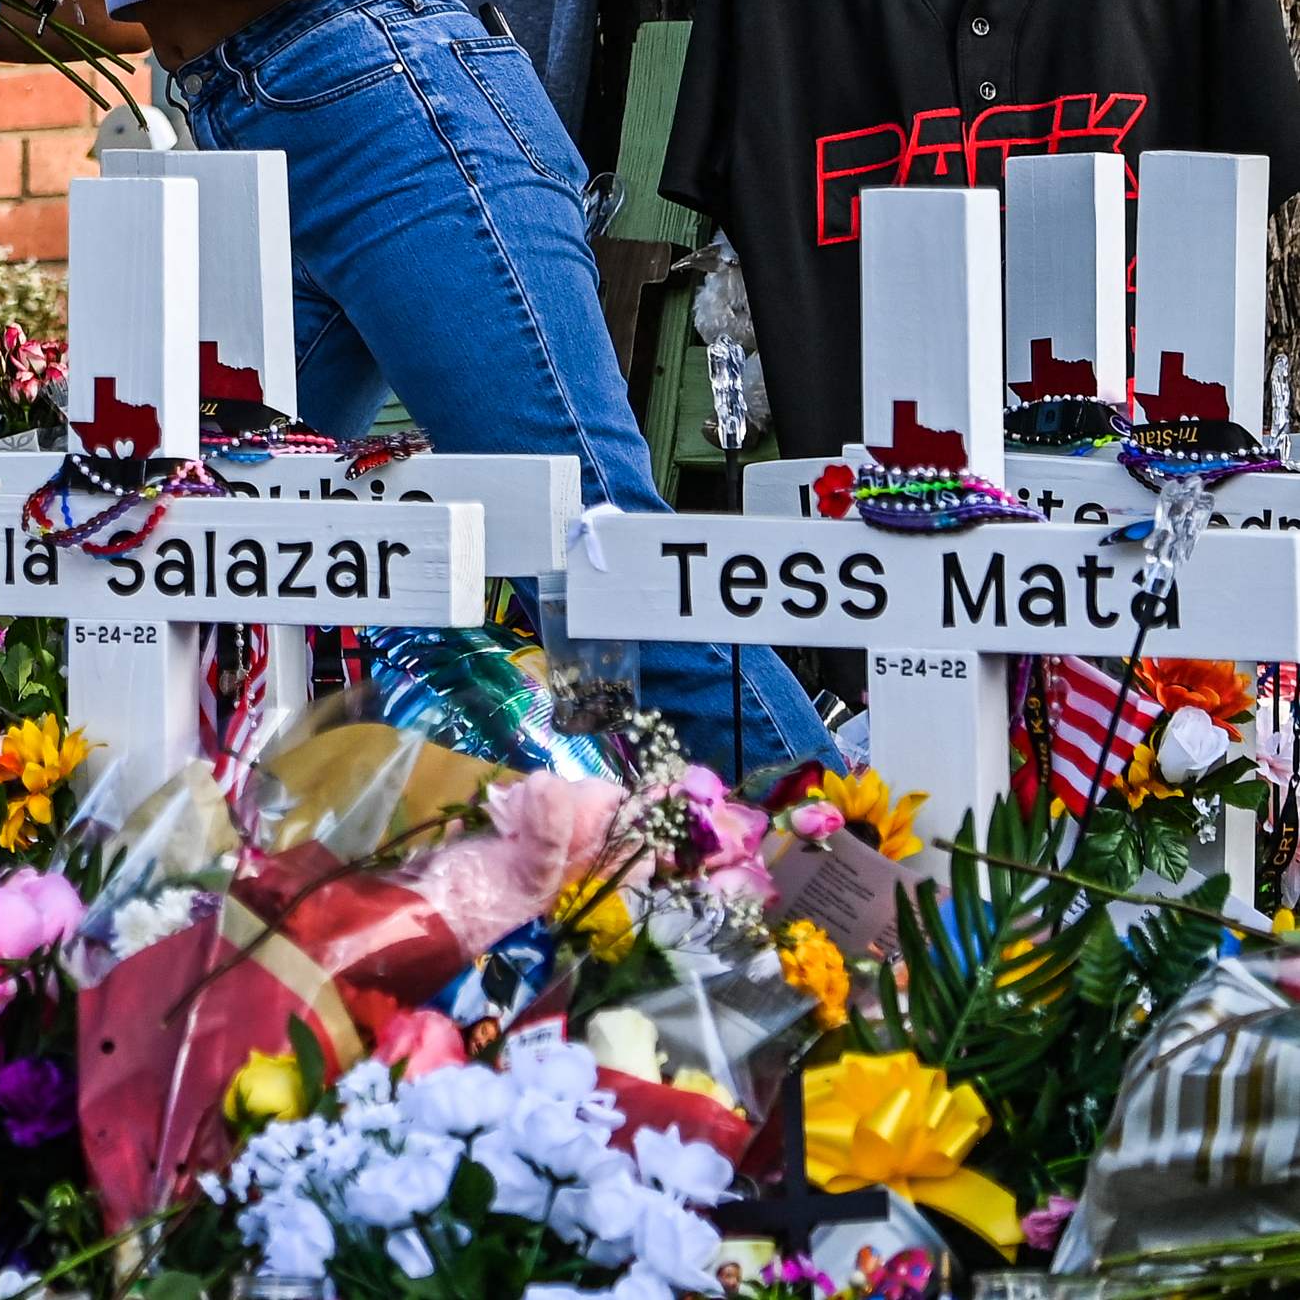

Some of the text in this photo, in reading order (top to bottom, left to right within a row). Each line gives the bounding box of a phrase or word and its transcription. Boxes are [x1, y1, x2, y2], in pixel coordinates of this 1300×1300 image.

[107, 530, 411, 599] Salazar
[661, 542, 1182, 630] Tess Mata
[75, 624, 158, 646] 5-24-22
[875, 654, 968, 681] 5-24-22
